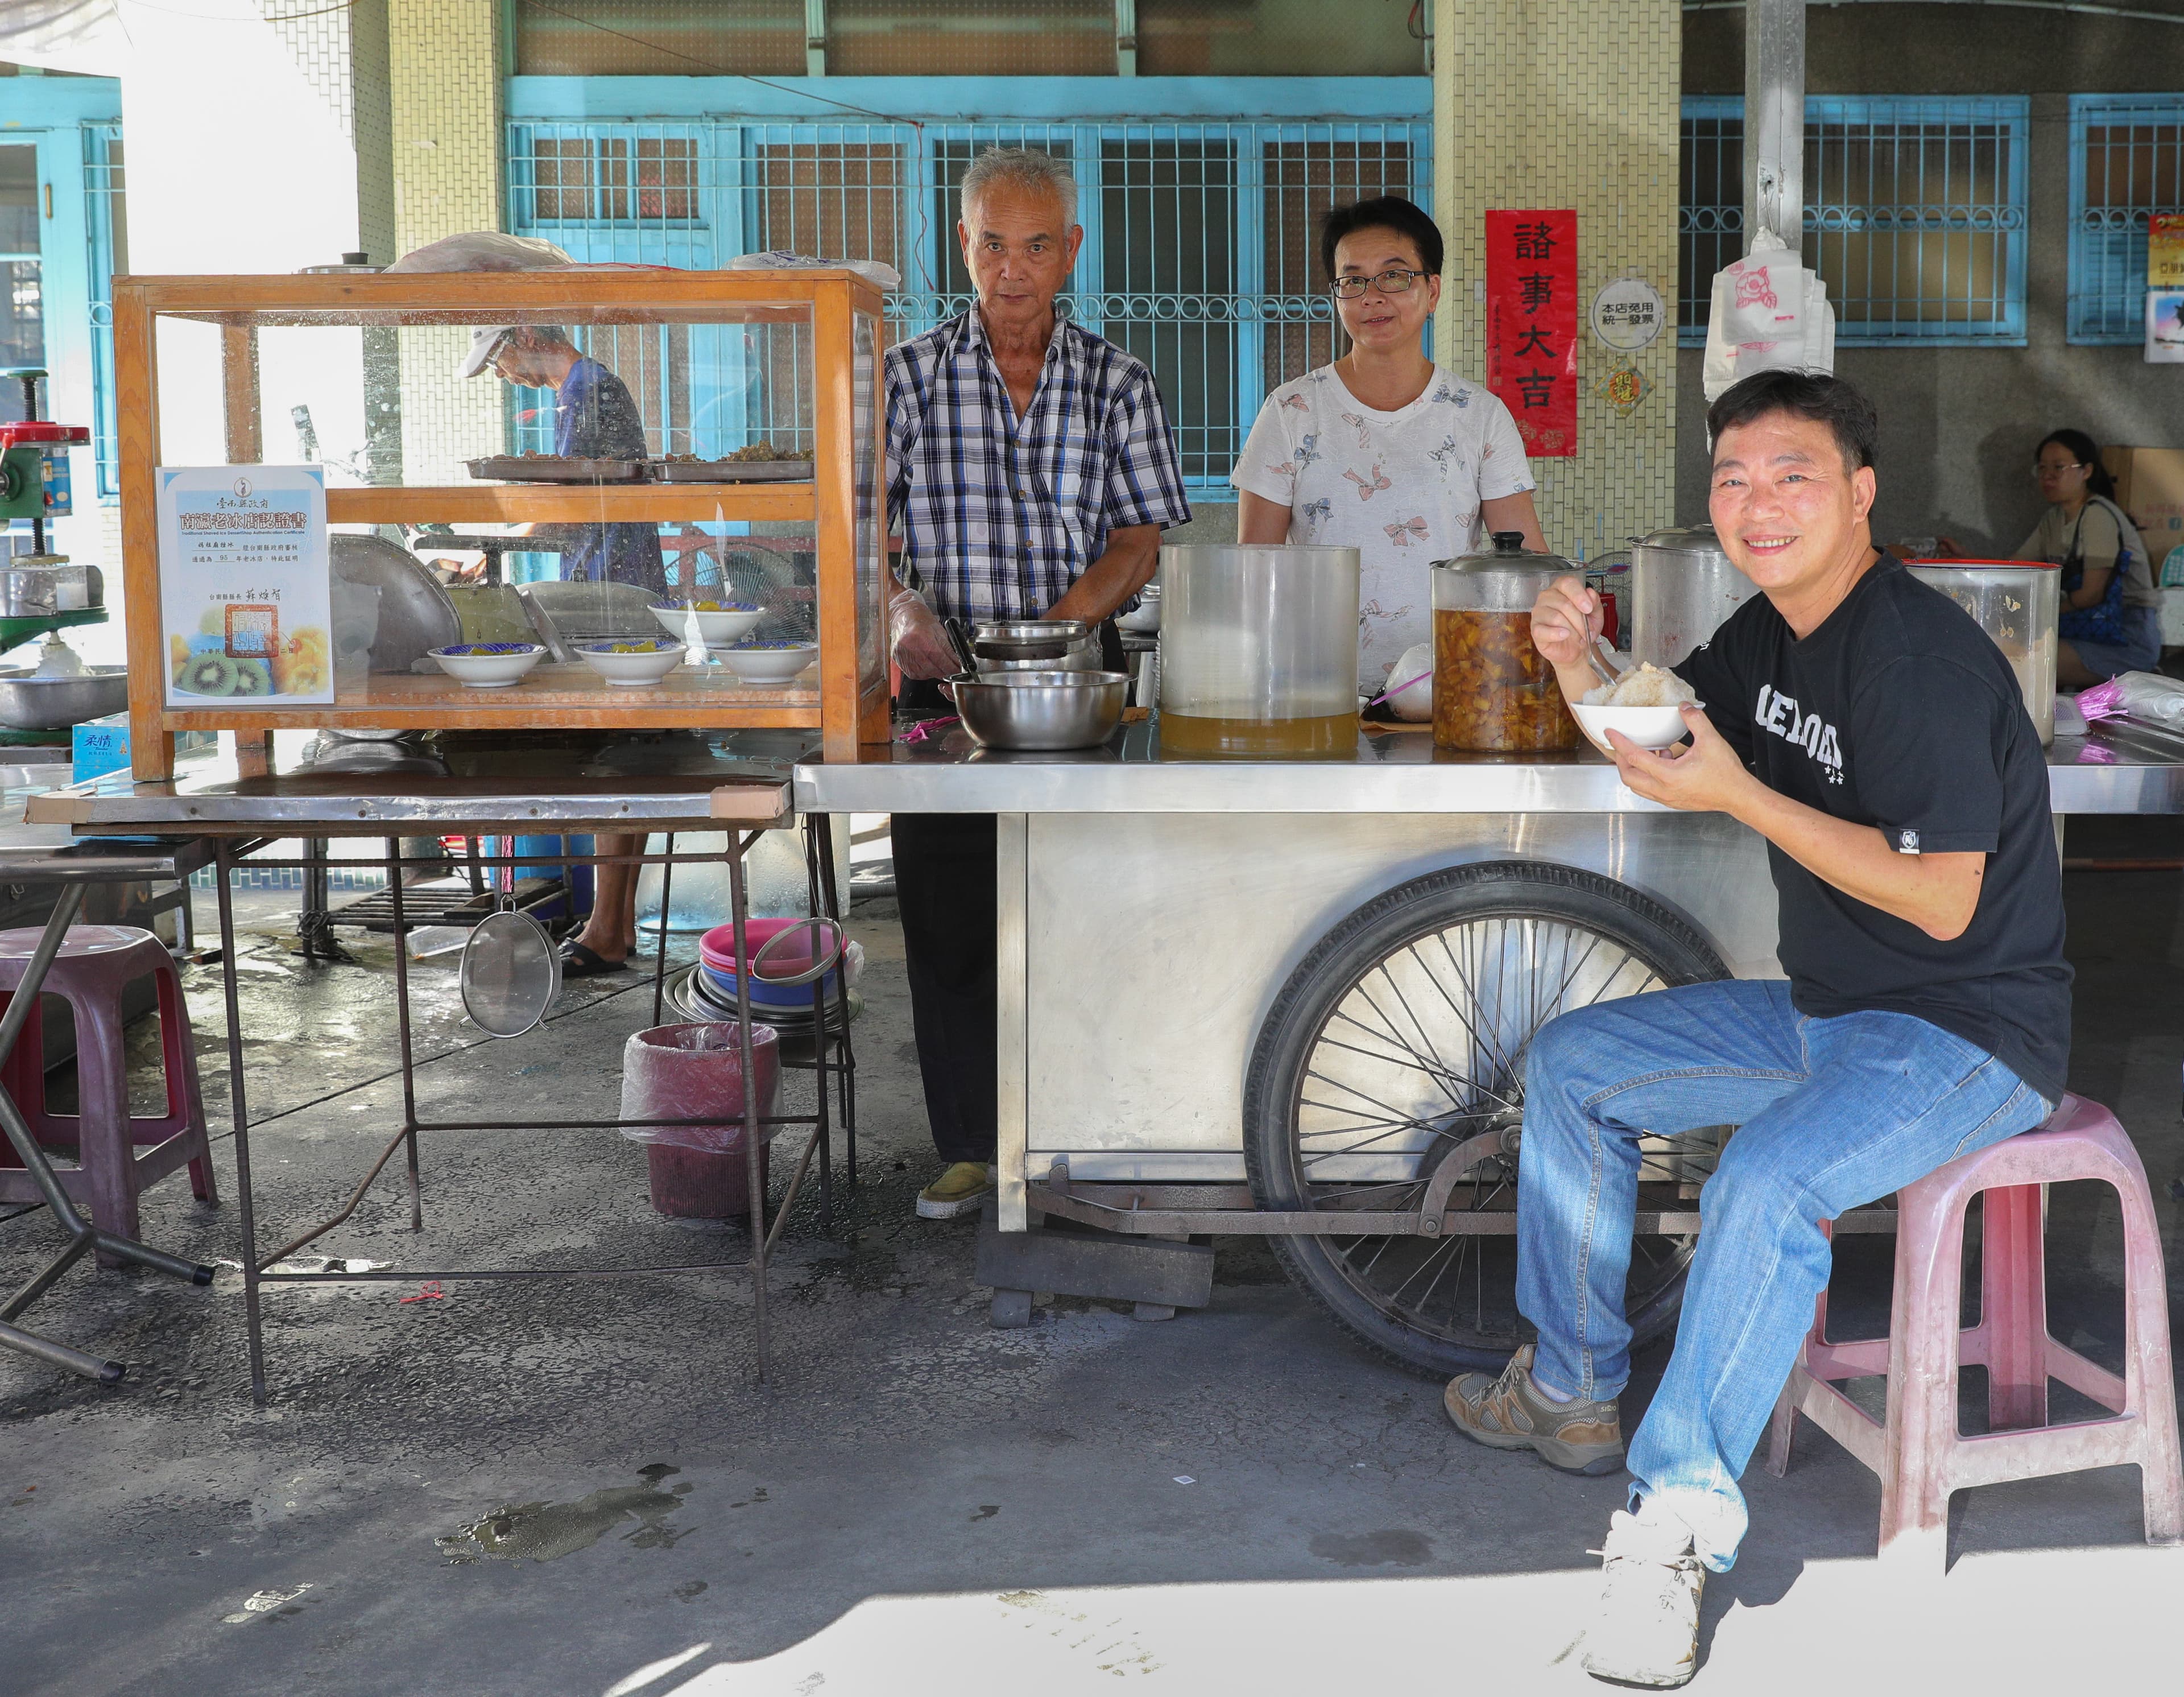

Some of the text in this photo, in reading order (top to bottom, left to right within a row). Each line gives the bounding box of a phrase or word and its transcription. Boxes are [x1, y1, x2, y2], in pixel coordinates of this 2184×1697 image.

[1513, 221, 1558, 409] 諸事大吉
[1602, 303, 1653, 313] 本店免用
[1602, 314, 1654, 325] 統一發票
[180, 511, 307, 530] 南瀛老冰店認證書
[83, 734, 112, 748] 柔情
